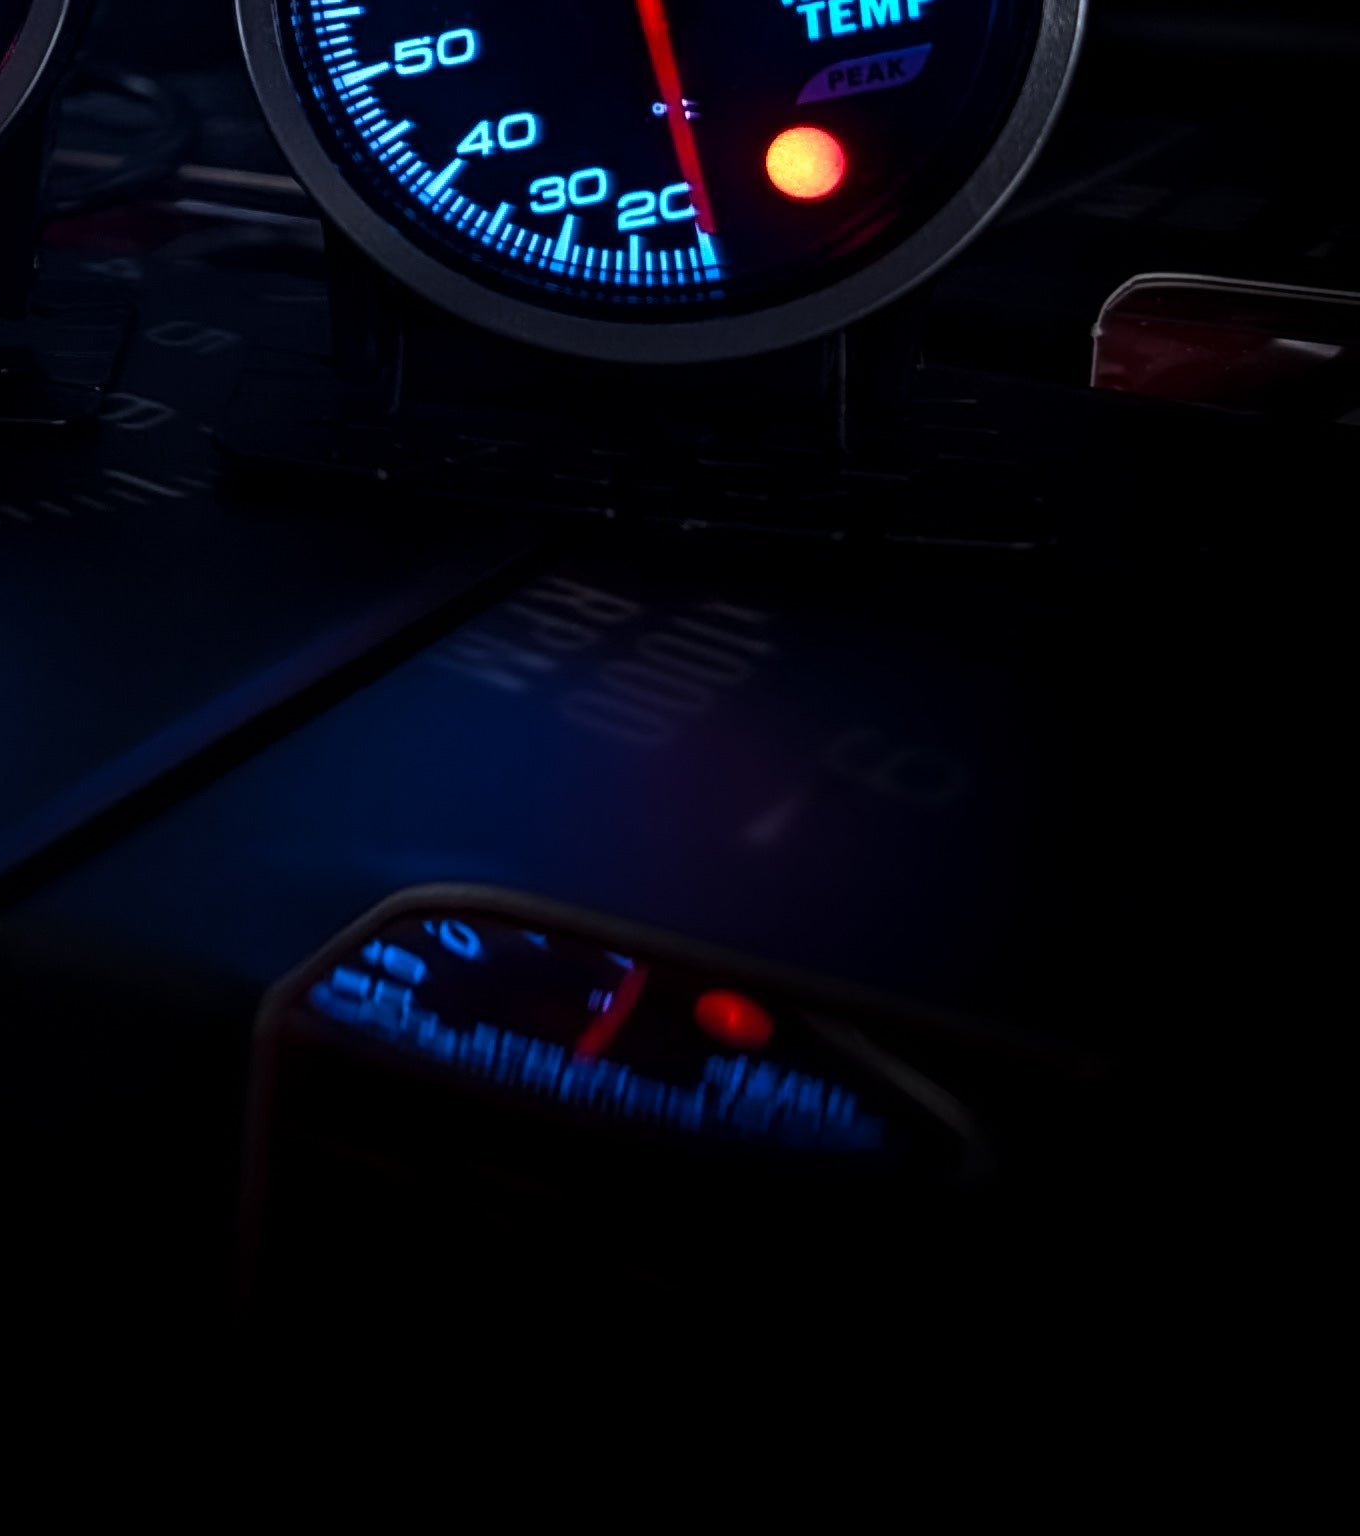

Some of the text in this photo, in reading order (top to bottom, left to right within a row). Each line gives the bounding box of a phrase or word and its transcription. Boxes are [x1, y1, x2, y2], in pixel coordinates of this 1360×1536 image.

[389, 28, 480, 76] 50
[827, 61, 908, 91] PEAK
[456, 112, 541, 156] 40
[529, 167, 611, 214] 30
[617, 183, 698, 231] 20
